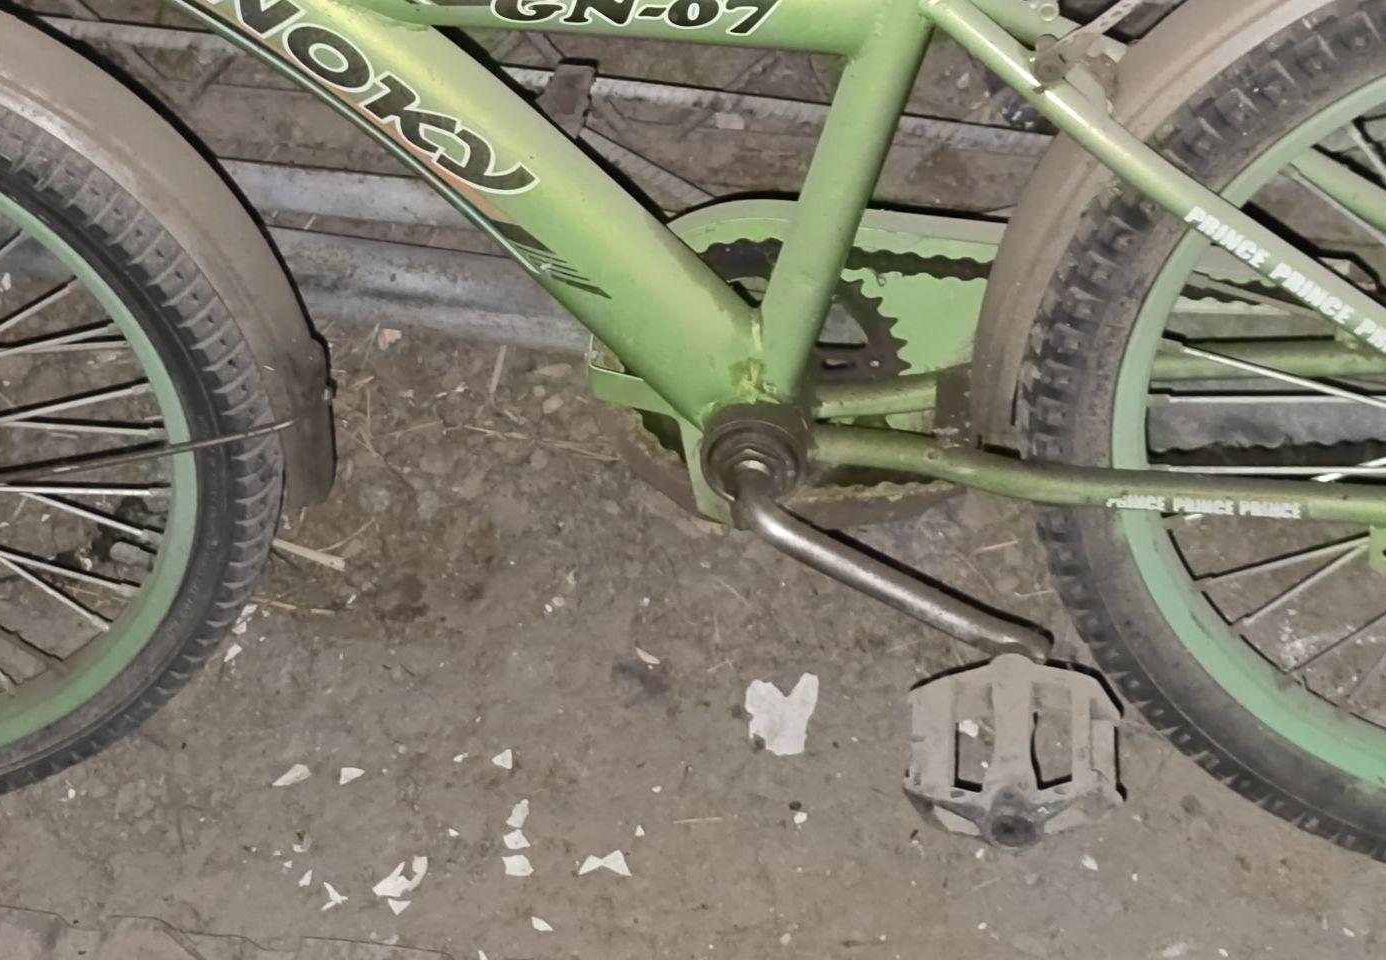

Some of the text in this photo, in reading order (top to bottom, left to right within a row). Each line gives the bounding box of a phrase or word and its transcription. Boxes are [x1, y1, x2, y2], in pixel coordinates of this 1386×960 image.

[1184, 206, 1270, 269] PRINCE
[1269, 262, 1356, 325] PRINCE
[1172, 497, 1235, 516] PRINCE
[1239, 500, 1302, 520] PRINCE
